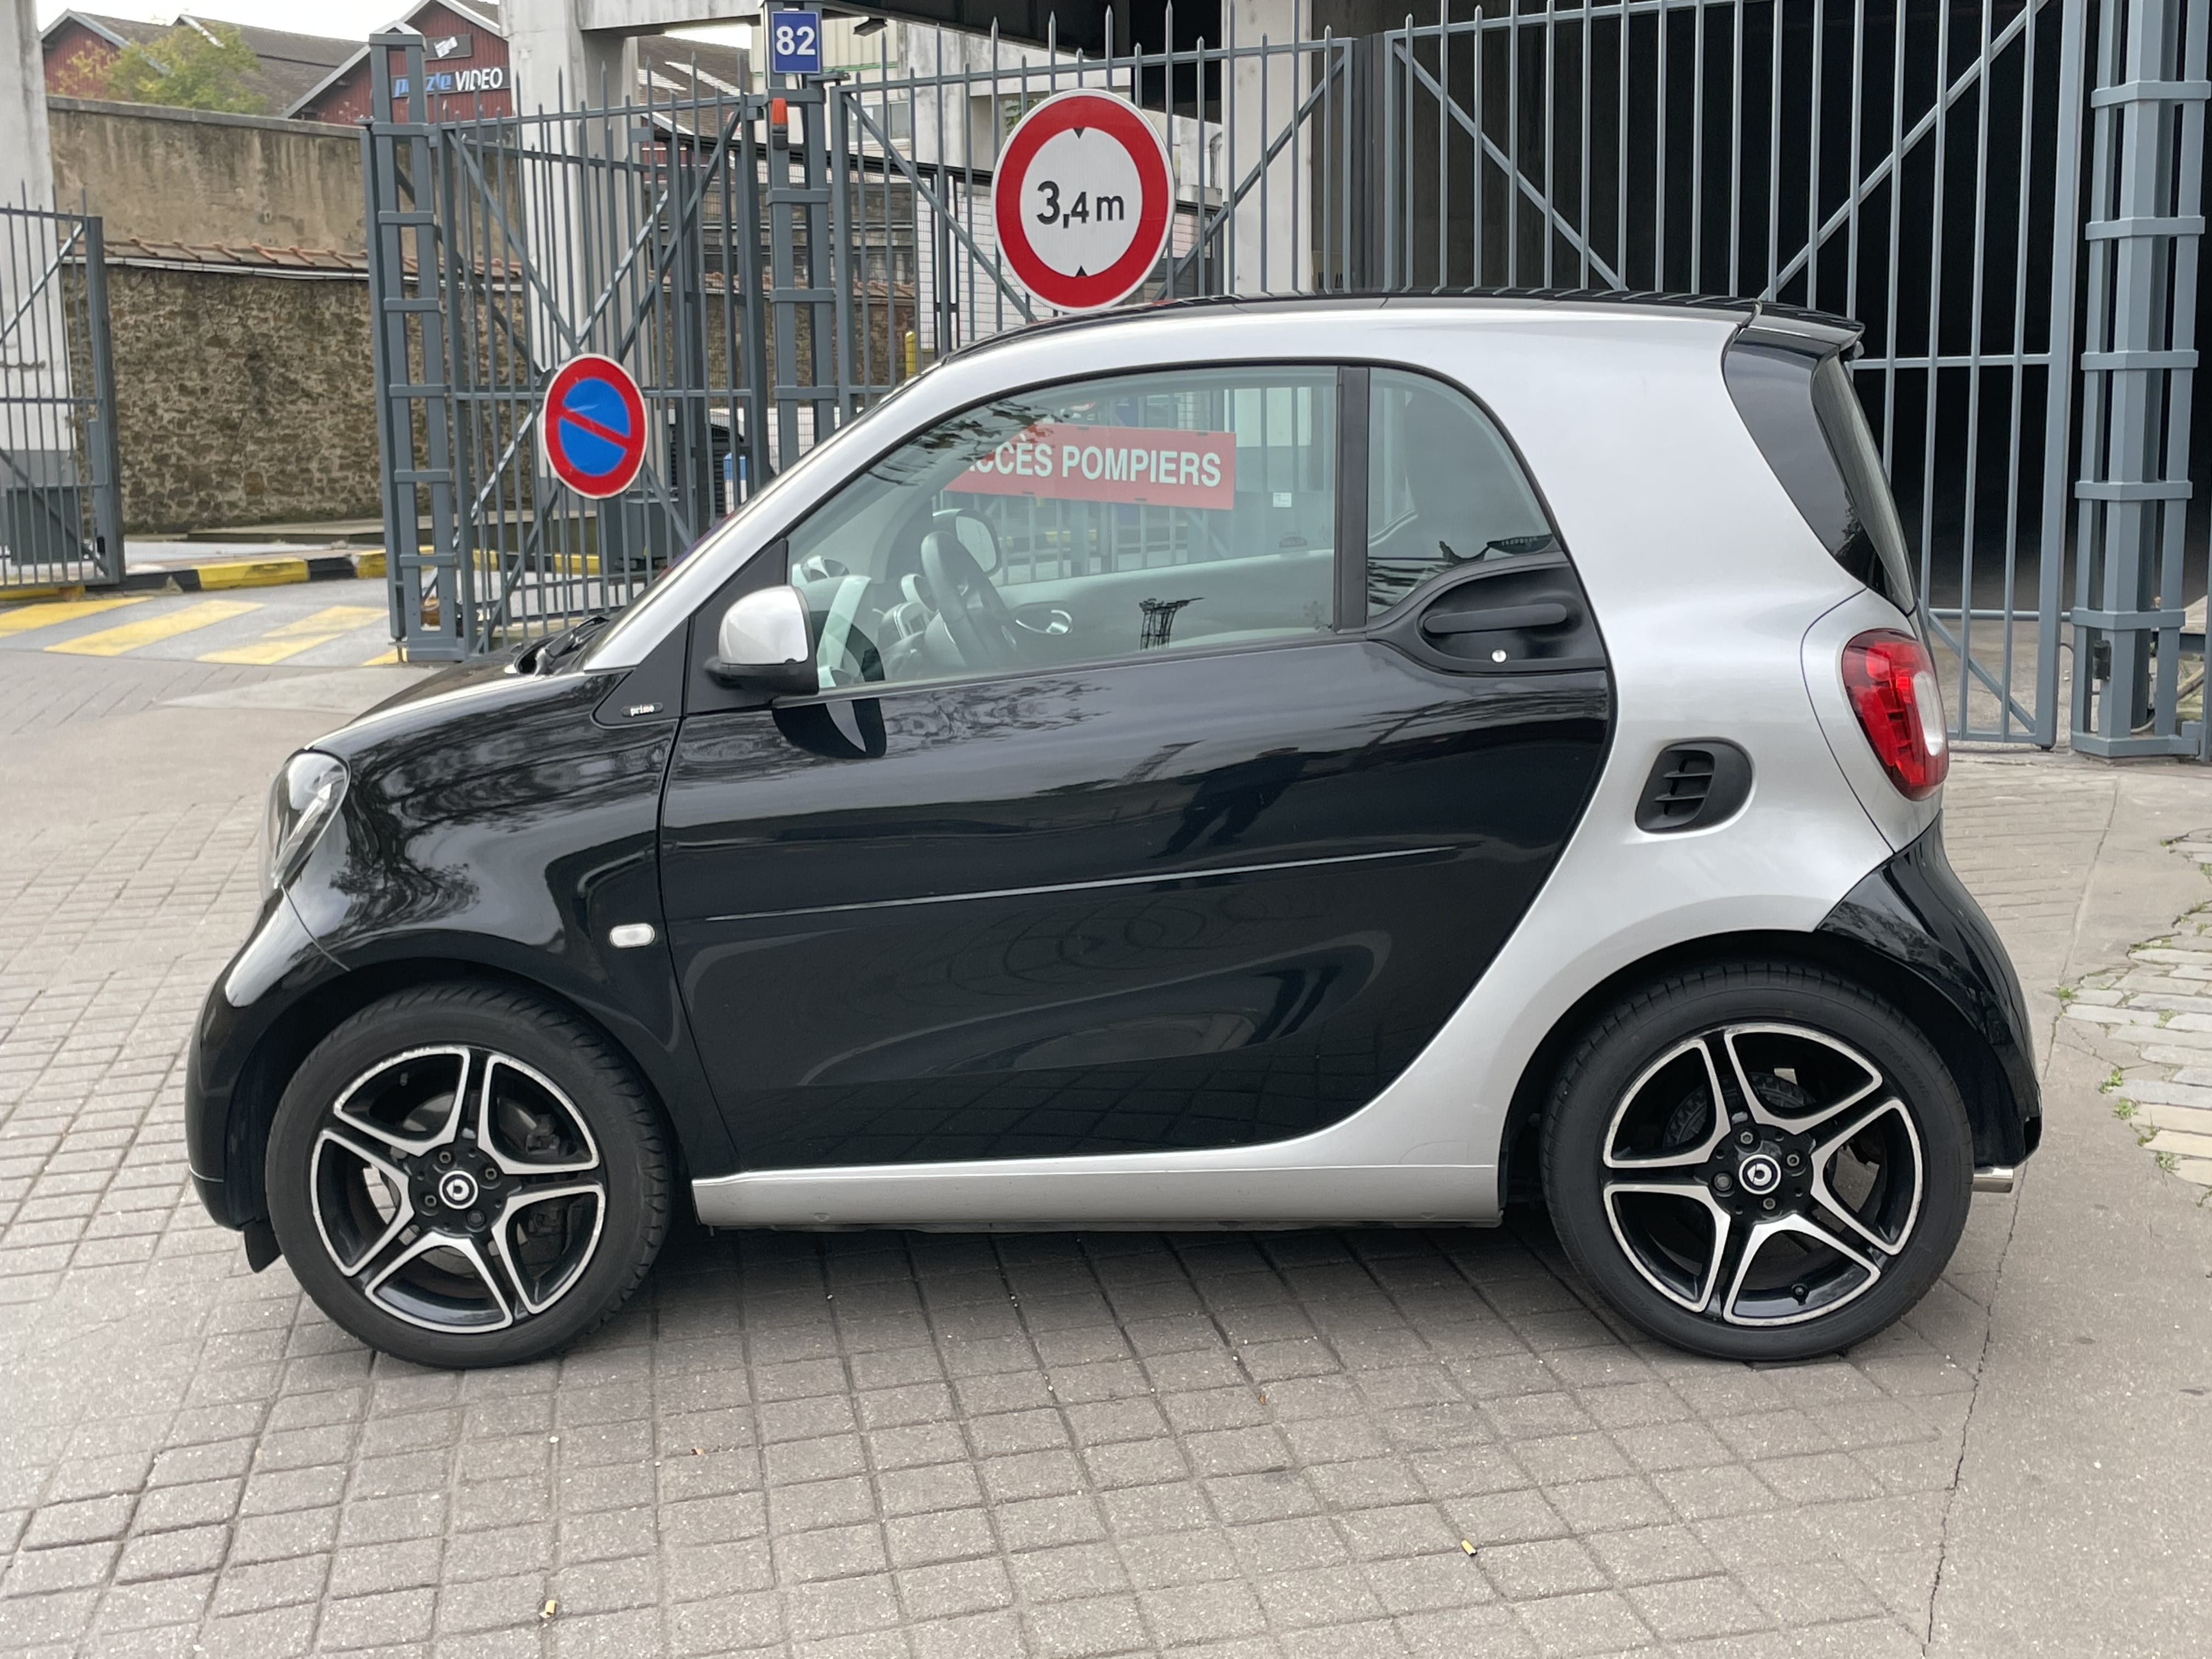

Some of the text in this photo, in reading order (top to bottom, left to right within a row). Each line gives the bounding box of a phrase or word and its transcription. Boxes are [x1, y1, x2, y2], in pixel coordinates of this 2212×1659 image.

[776, 26, 816, 55] 82
[455, 67, 503, 92] VIDEO
[1036, 180, 1125, 229] 3,4 m
[969, 433, 1221, 488] CÈS POMPIERS
